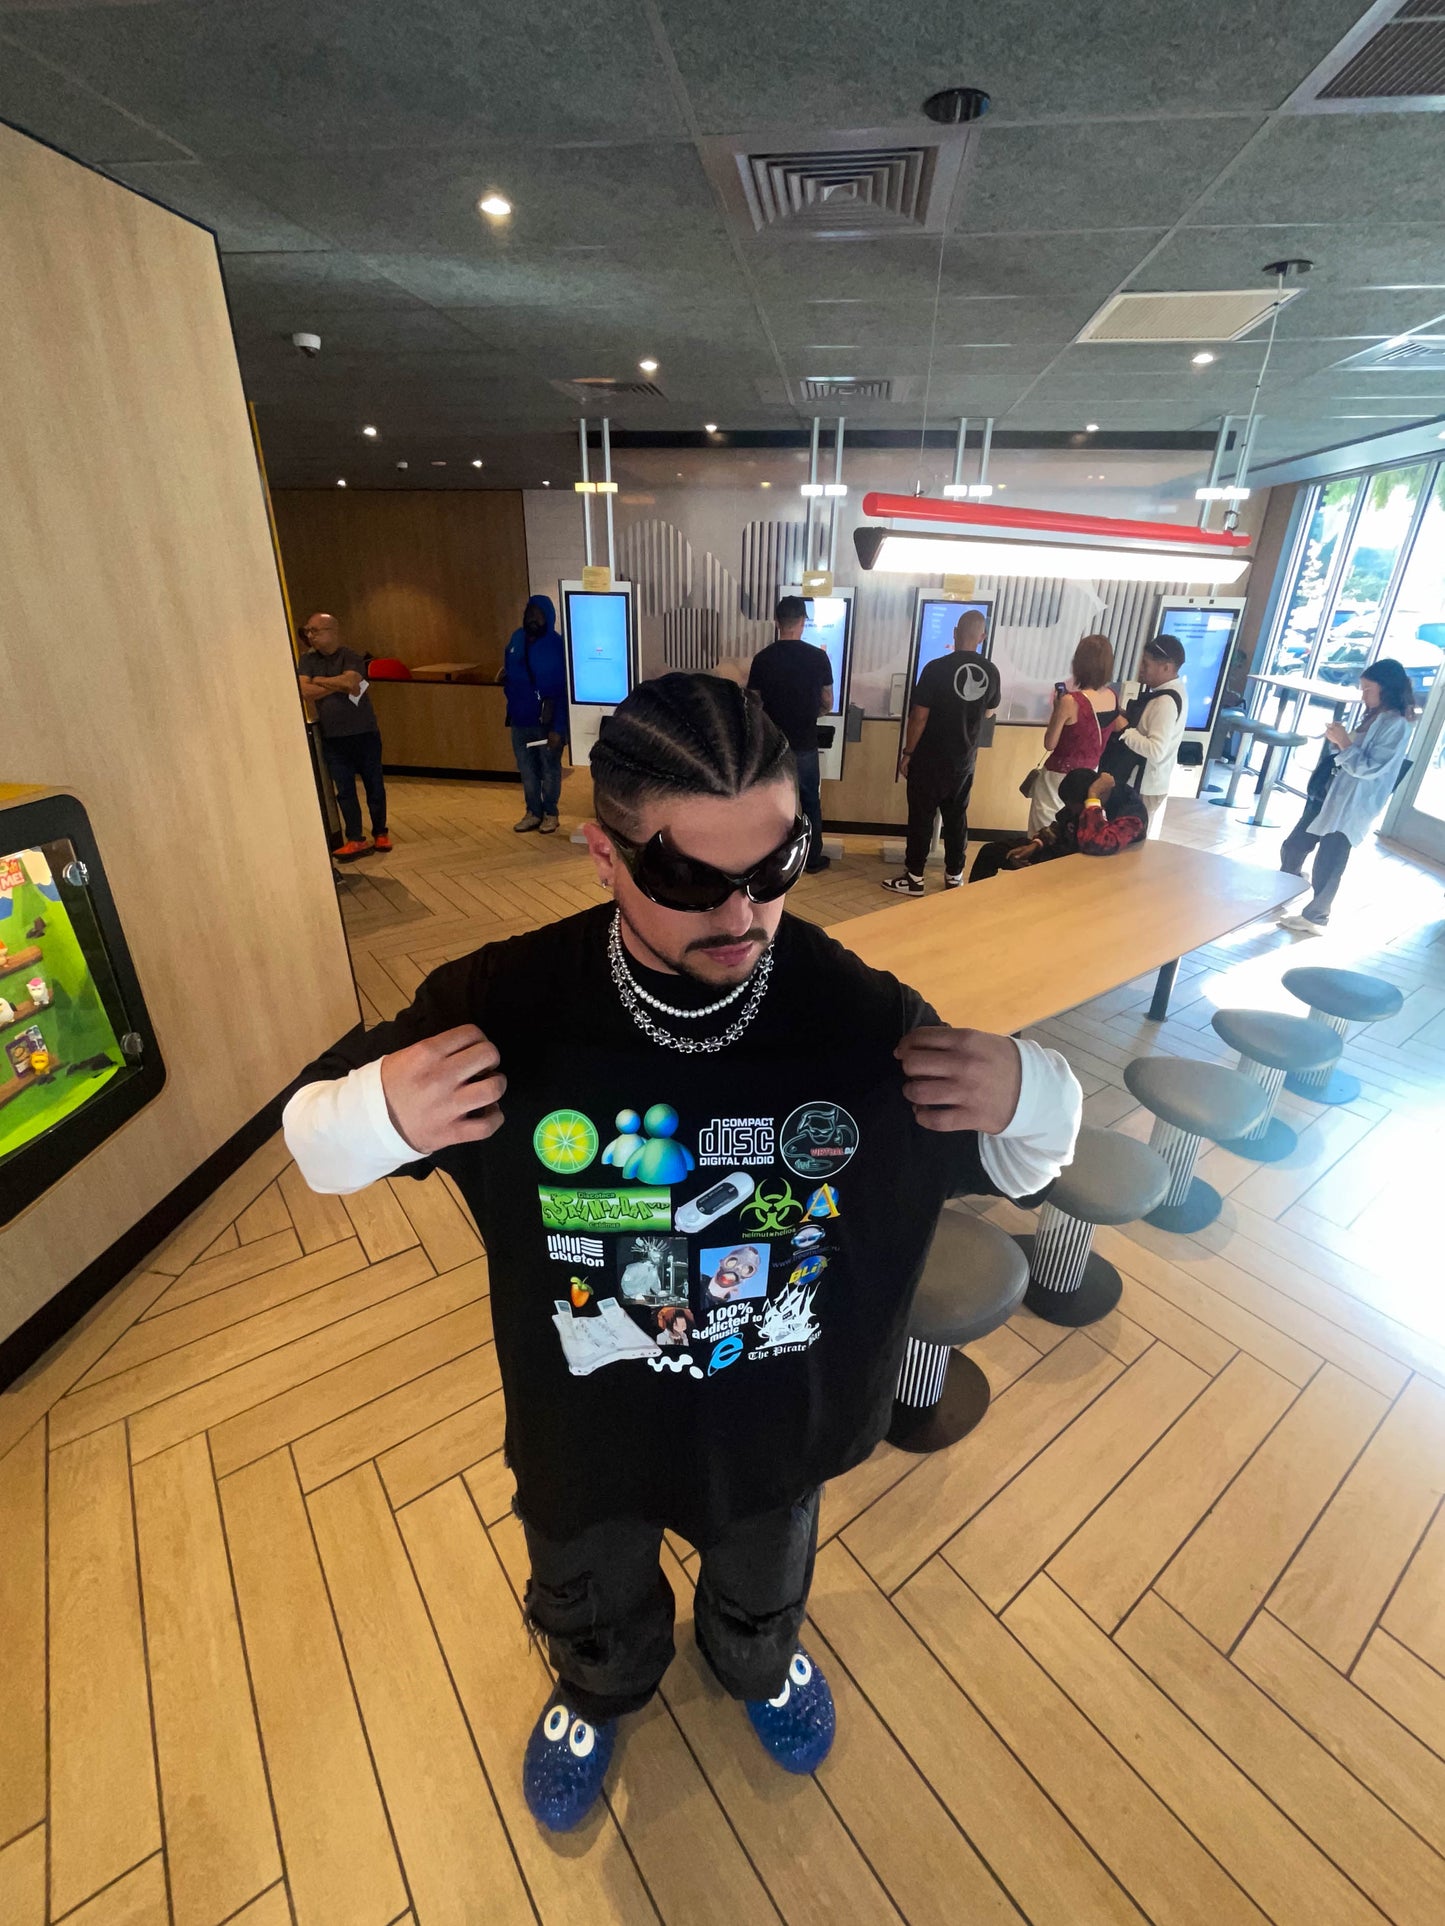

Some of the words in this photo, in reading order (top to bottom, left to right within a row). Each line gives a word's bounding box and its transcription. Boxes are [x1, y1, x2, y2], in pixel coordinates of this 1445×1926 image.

[722, 1117, 774, 1127] COMPACT
[699, 1156, 740, 1166] DIGITAL
[742, 1155, 774, 1165] AUDIO
[549, 1247, 605, 1267] ableton
[706, 1301, 754, 1325] 100%
[691, 1313, 749, 1340] addicted
[752, 1315, 763, 1323] to
[709, 1326, 740, 1343] music
[748, 1351, 769, 1361] The
[772, 1344, 807, 1357] Pirate
